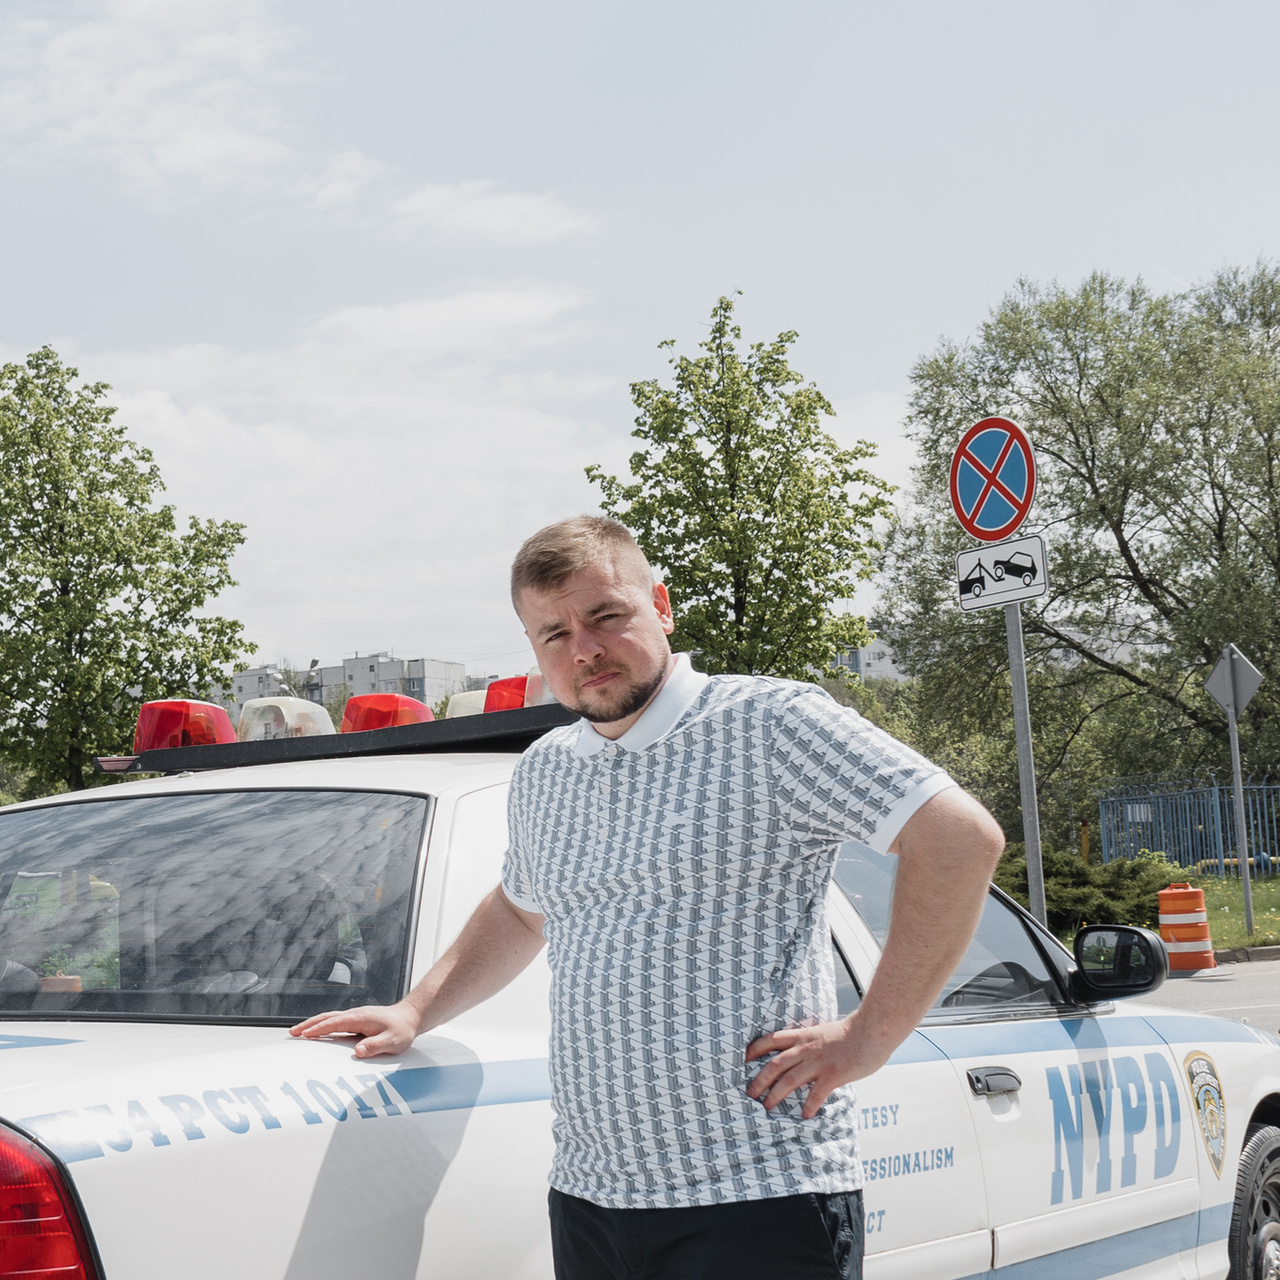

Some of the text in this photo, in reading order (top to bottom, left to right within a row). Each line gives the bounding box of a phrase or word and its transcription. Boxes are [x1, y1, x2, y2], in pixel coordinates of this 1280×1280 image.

[158, 1085, 283, 1142] PCT
[280, 1074, 403, 1126] 1017
[858, 1104, 900, 1130] TESY
[1045, 1052, 1182, 1206] NYPD
[864, 1209, 886, 1234] CT
